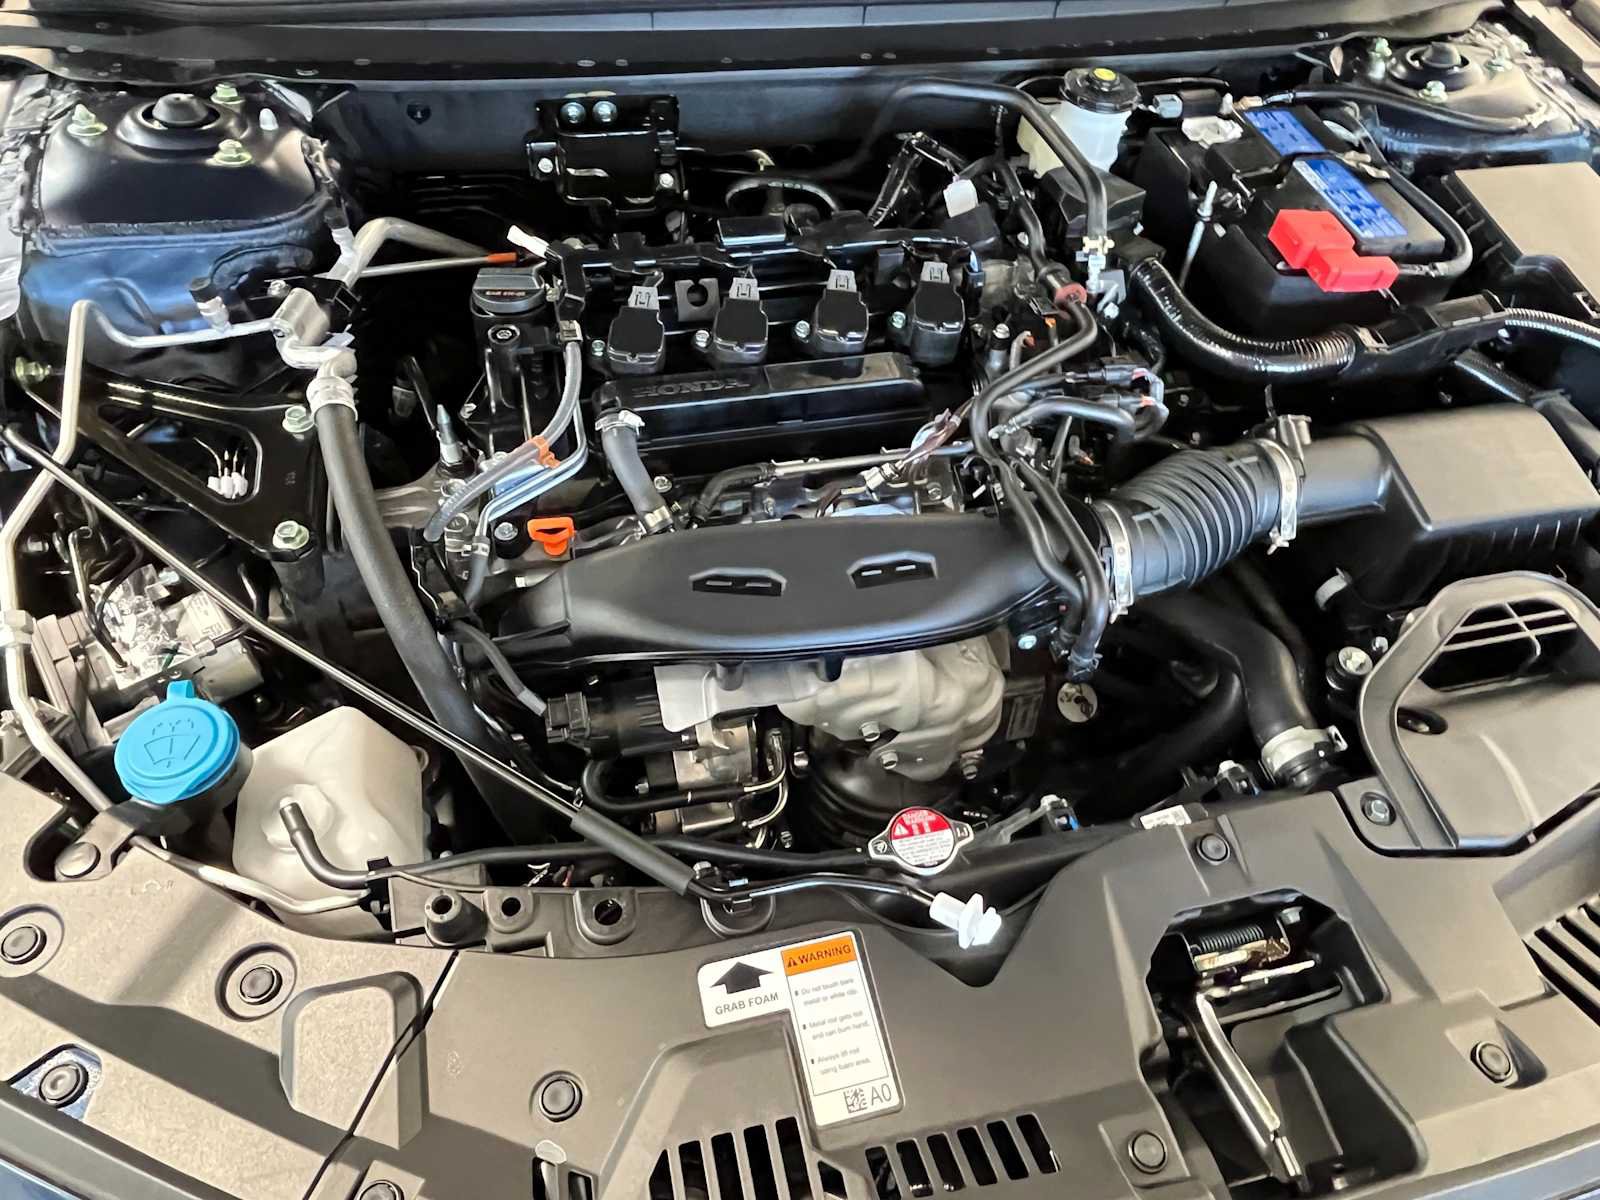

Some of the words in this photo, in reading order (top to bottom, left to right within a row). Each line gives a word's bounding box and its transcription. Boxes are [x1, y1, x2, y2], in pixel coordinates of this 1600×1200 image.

[798, 944, 852, 964] WARNING
[715, 1000, 746, 1015] GRAB
[748, 992, 779, 1007] FOAM
